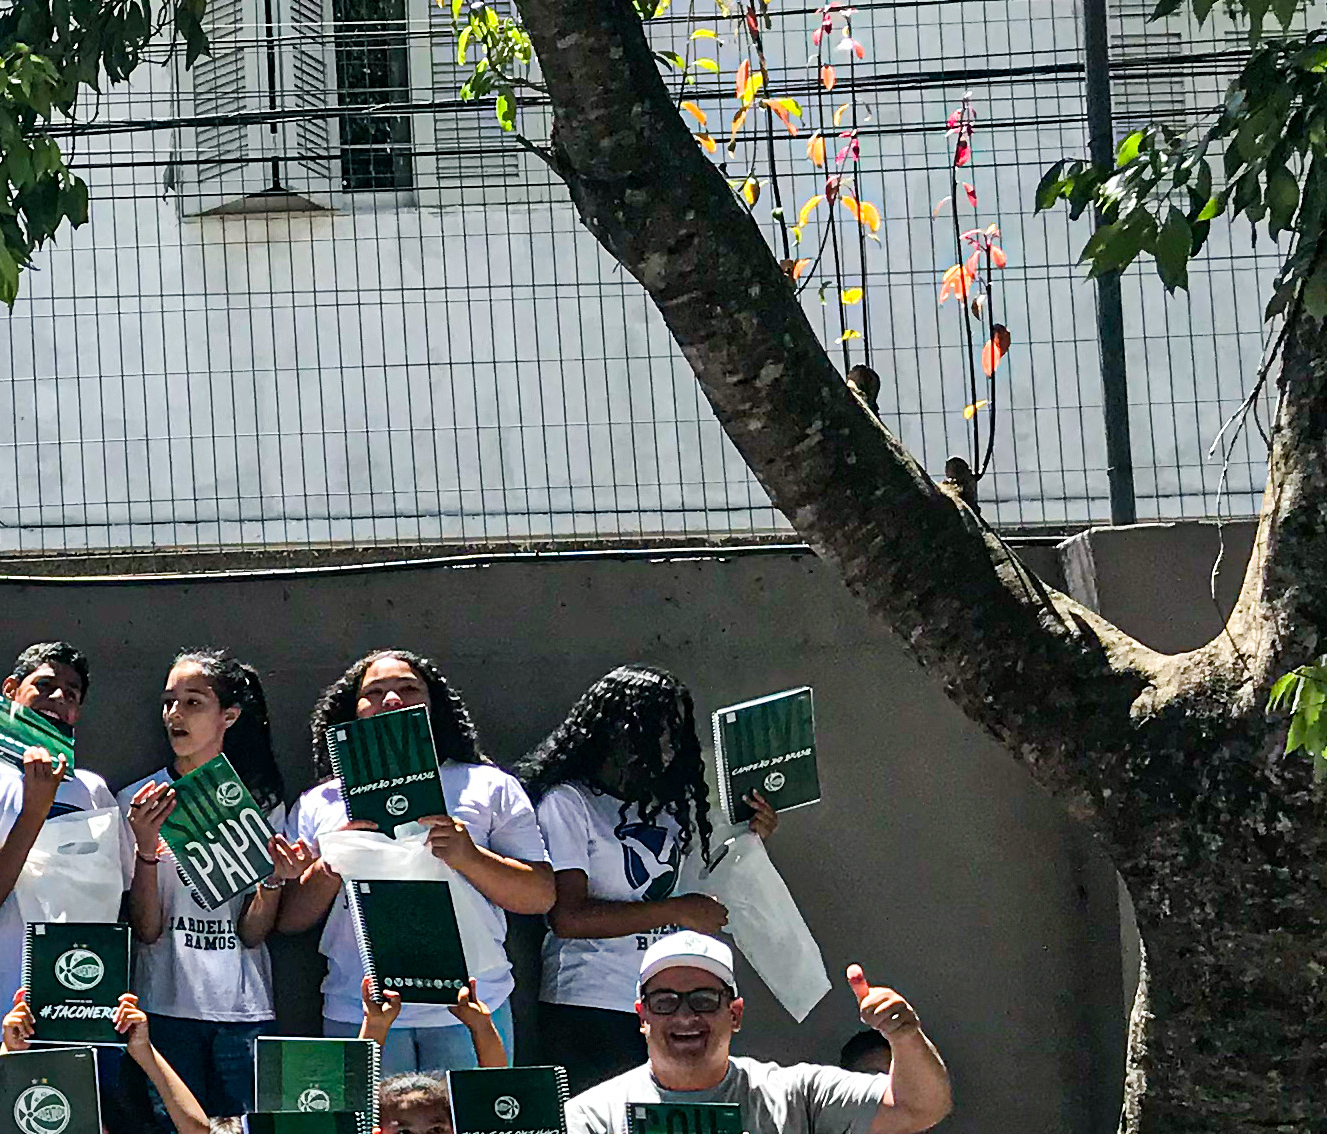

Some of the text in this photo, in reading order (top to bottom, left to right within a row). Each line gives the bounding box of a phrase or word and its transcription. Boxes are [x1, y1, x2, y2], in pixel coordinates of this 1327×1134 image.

[770, 755, 783, 766] DO
[390, 776, 404, 788] DO
[405, 770, 435, 784] BRASIL
[169, 916, 236, 934] JARDELI
[185, 933, 236, 950] RAMOS
